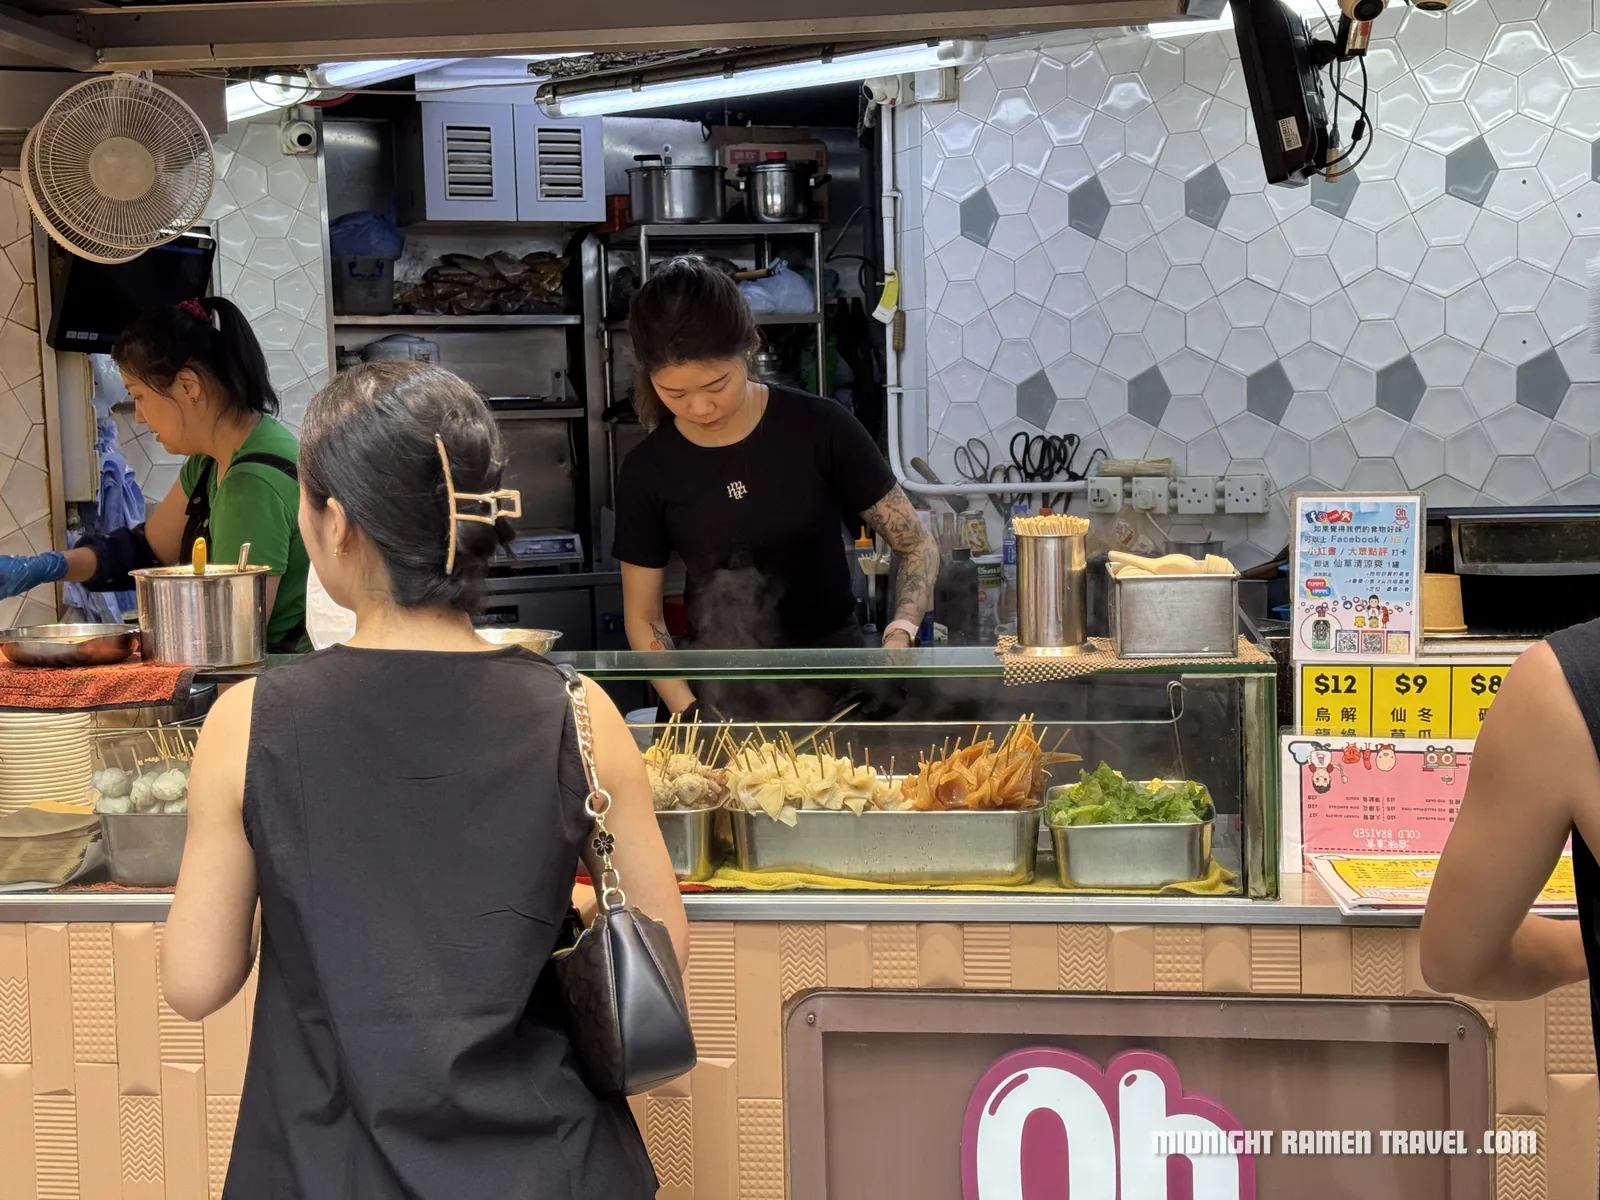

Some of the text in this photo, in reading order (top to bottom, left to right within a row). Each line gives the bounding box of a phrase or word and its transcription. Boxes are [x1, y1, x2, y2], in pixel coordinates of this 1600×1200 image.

[1331, 535, 1380, 543] Facebook
[1308, 547, 1337, 555] 小紅書
[1348, 547, 1389, 556] 大眾點評
[1314, 560, 1330, 568] 即送
[1314, 673, 1357, 695] $12
[1395, 673, 1428, 695] $9
[1470, 673, 1502, 695] $8
[1353, 828, 1421, 840] COLD BRAISED
